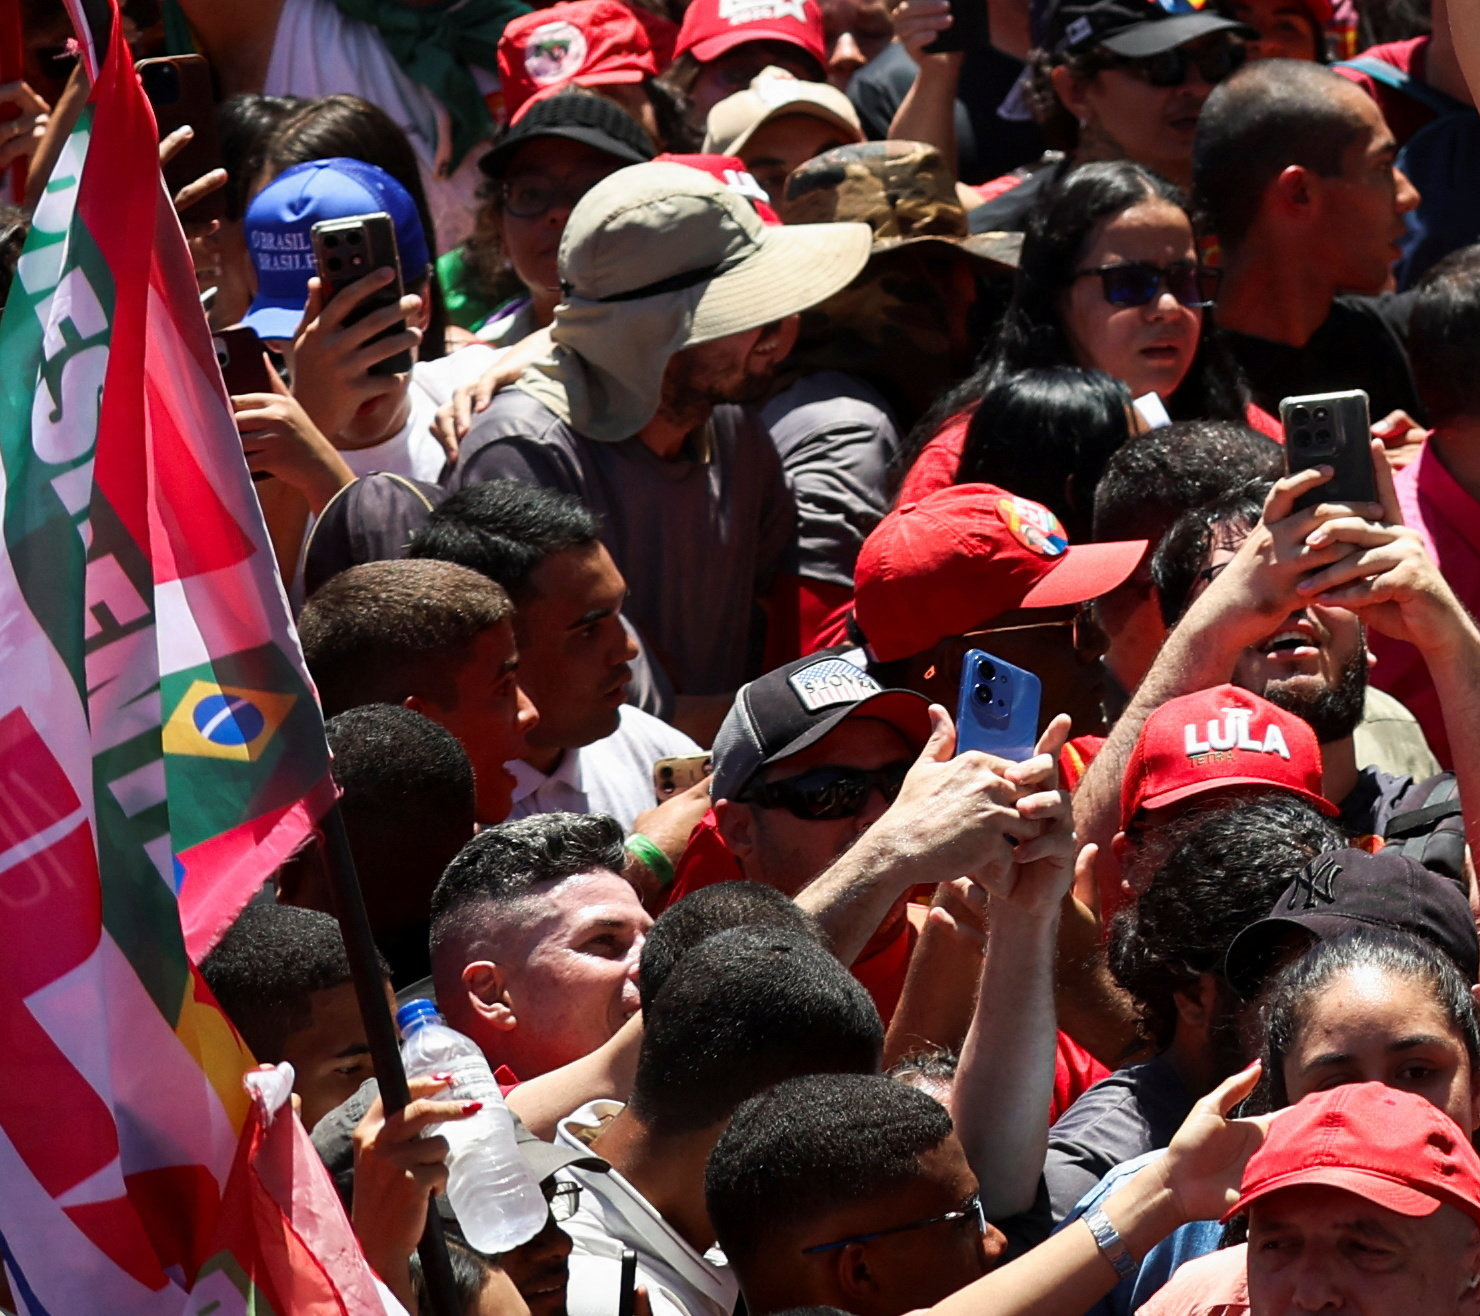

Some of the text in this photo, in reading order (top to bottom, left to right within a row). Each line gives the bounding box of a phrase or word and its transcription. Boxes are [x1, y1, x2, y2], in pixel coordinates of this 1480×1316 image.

[261, 230, 308, 249] BRASIL
[1184, 715, 1291, 760] LULA
[1286, 856, 1343, 912] NY
